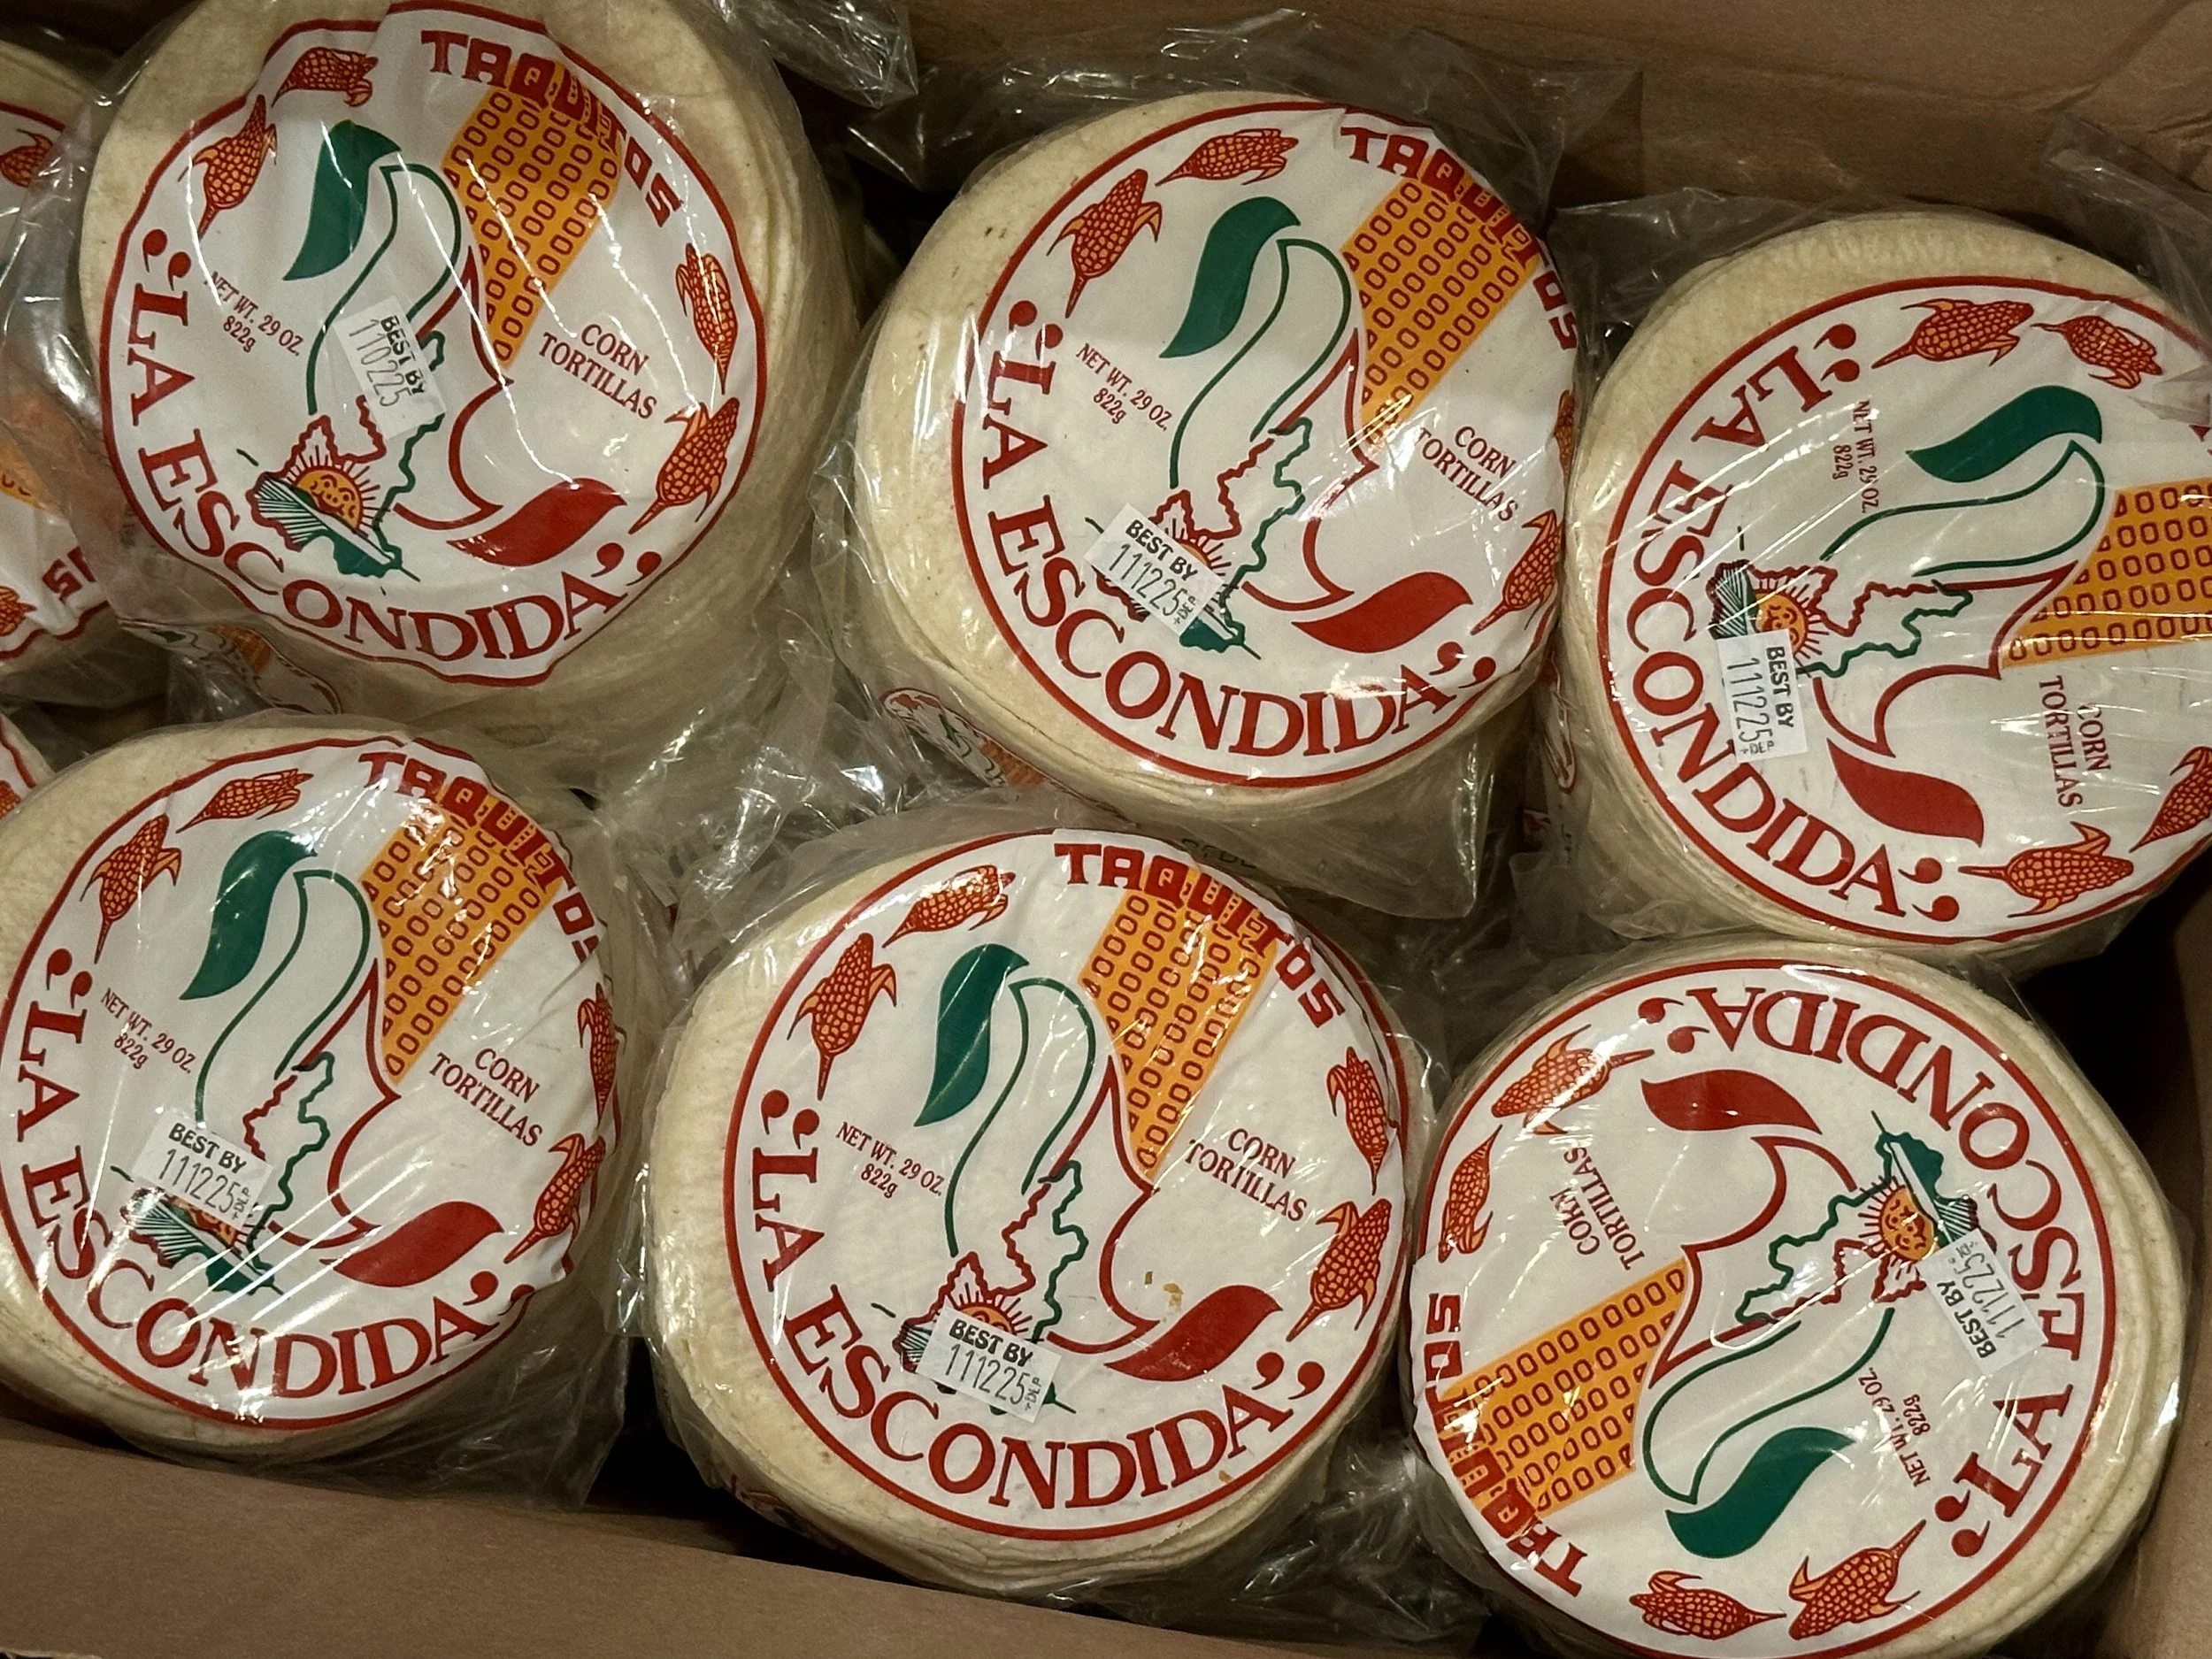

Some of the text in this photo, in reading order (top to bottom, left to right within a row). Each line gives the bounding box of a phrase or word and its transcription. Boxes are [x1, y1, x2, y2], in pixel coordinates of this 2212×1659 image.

[420, 30, 683, 227] TAQUITOS
[1340, 127, 1578, 351] TAQUITOS
[204, 271, 306, 356] NET WT. 29 OZ.
[223, 315, 257, 353] 822g
[349, 319, 415, 408] 110225
[380, 315, 426, 396] BEST BY
[538, 331, 658, 420] TORTILLAS
[580, 324, 649, 376] CORN
[1076, 342, 1174, 432] NET WT. 29 OZ.
[1093, 388, 1127, 425] 822g
[1417, 426, 1519, 522] TORTILLAS
[1454, 426, 1517, 480] CORN
[1832, 444, 1855, 480] 822g
[1852, 399, 1880, 513] NET WT. 29 OZ.
[1109, 543, 1188, 617] 111225
[1125, 519, 1198, 581] BEST BY
[1726, 657, 1774, 743] 111225
[1765, 646, 1795, 729] BEST BY
[2038, 674, 2084, 808] TORTILLAS
[2077, 704, 2112, 772] CORN
[1054, 842, 1346, 1028] TAQUITOS
[101, 987, 196, 1074] NET WT. 29 OZ.
[113, 1032, 149, 1070] 822g
[428, 1052, 543, 1147] TORTILLAS
[473, 1048, 541, 1103] CORN
[158, 1148, 242, 1214] 111225
[168, 1122, 248, 1174] BEST BY
[835, 1120, 945, 1196] NET WT. 29 OZ.
[860, 1163, 899, 1199] 822g
[1184, 1138, 1308, 1222] TORTILLAS
[1227, 1127, 1297, 1179] CORN
[1549, 1187, 1601, 1256] CORN
[1563, 1146, 1646, 1271] TORTILLAS
[1936, 1280, 1965, 1308] BY
[1953, 1252, 2025, 1339] 111225
[949, 1318, 1034, 1367] BEST BY
[1954, 1308, 1997, 1359] BEST
[945, 1343, 1031, 1405] 111225
[1857, 1366, 1883, 1396] OZ.
[1423, 1292, 1588, 1598] TAQUITOS
[1902, 1394, 1932, 1436] 822g
[1899, 1450, 1932, 1488] NET
